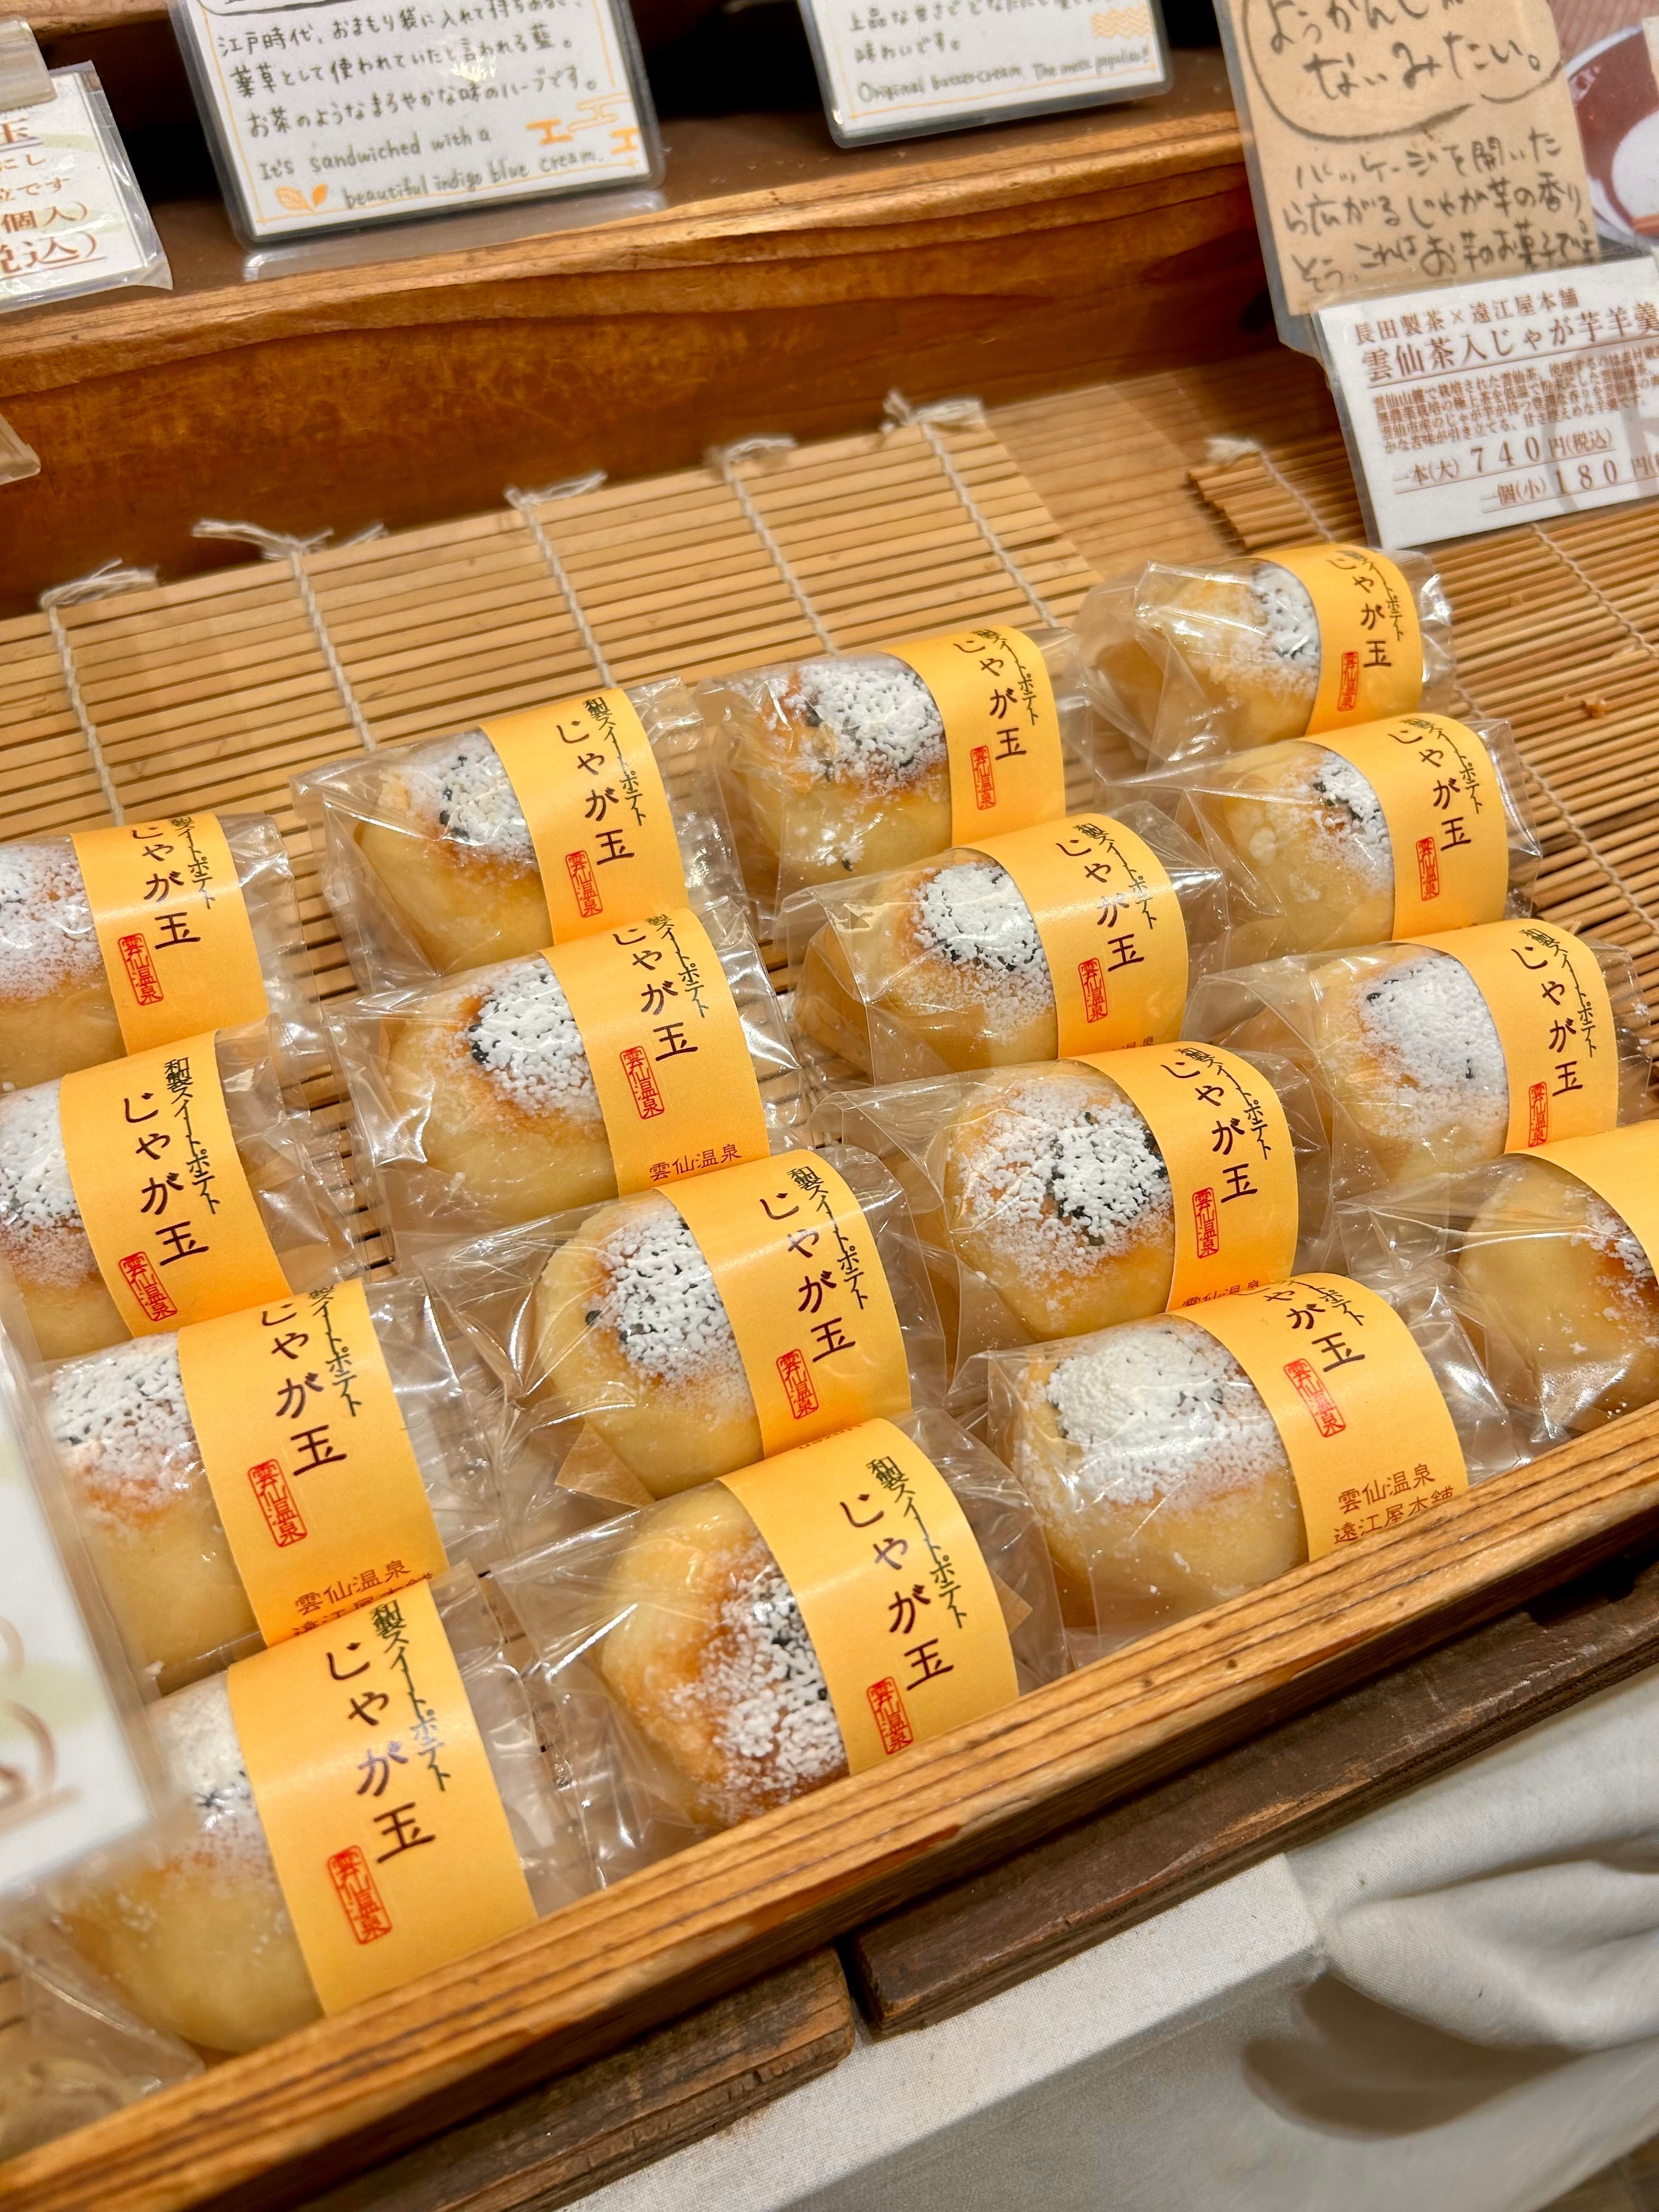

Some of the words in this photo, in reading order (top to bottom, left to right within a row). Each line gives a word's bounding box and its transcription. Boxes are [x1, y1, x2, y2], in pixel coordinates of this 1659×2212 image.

[1303, 30, 1541, 100] ないみたい。
[311, 132, 421, 173] sandwiched
[430, 126, 472, 152] with
[479, 128, 490, 142] a
[488, 159, 531, 184] blue
[649, 1143, 742, 1182] 雲仙温泉
[1338, 1463, 1436, 1515] 雲仙温泉
[295, 1560, 411, 1616] 雲仙温泉
